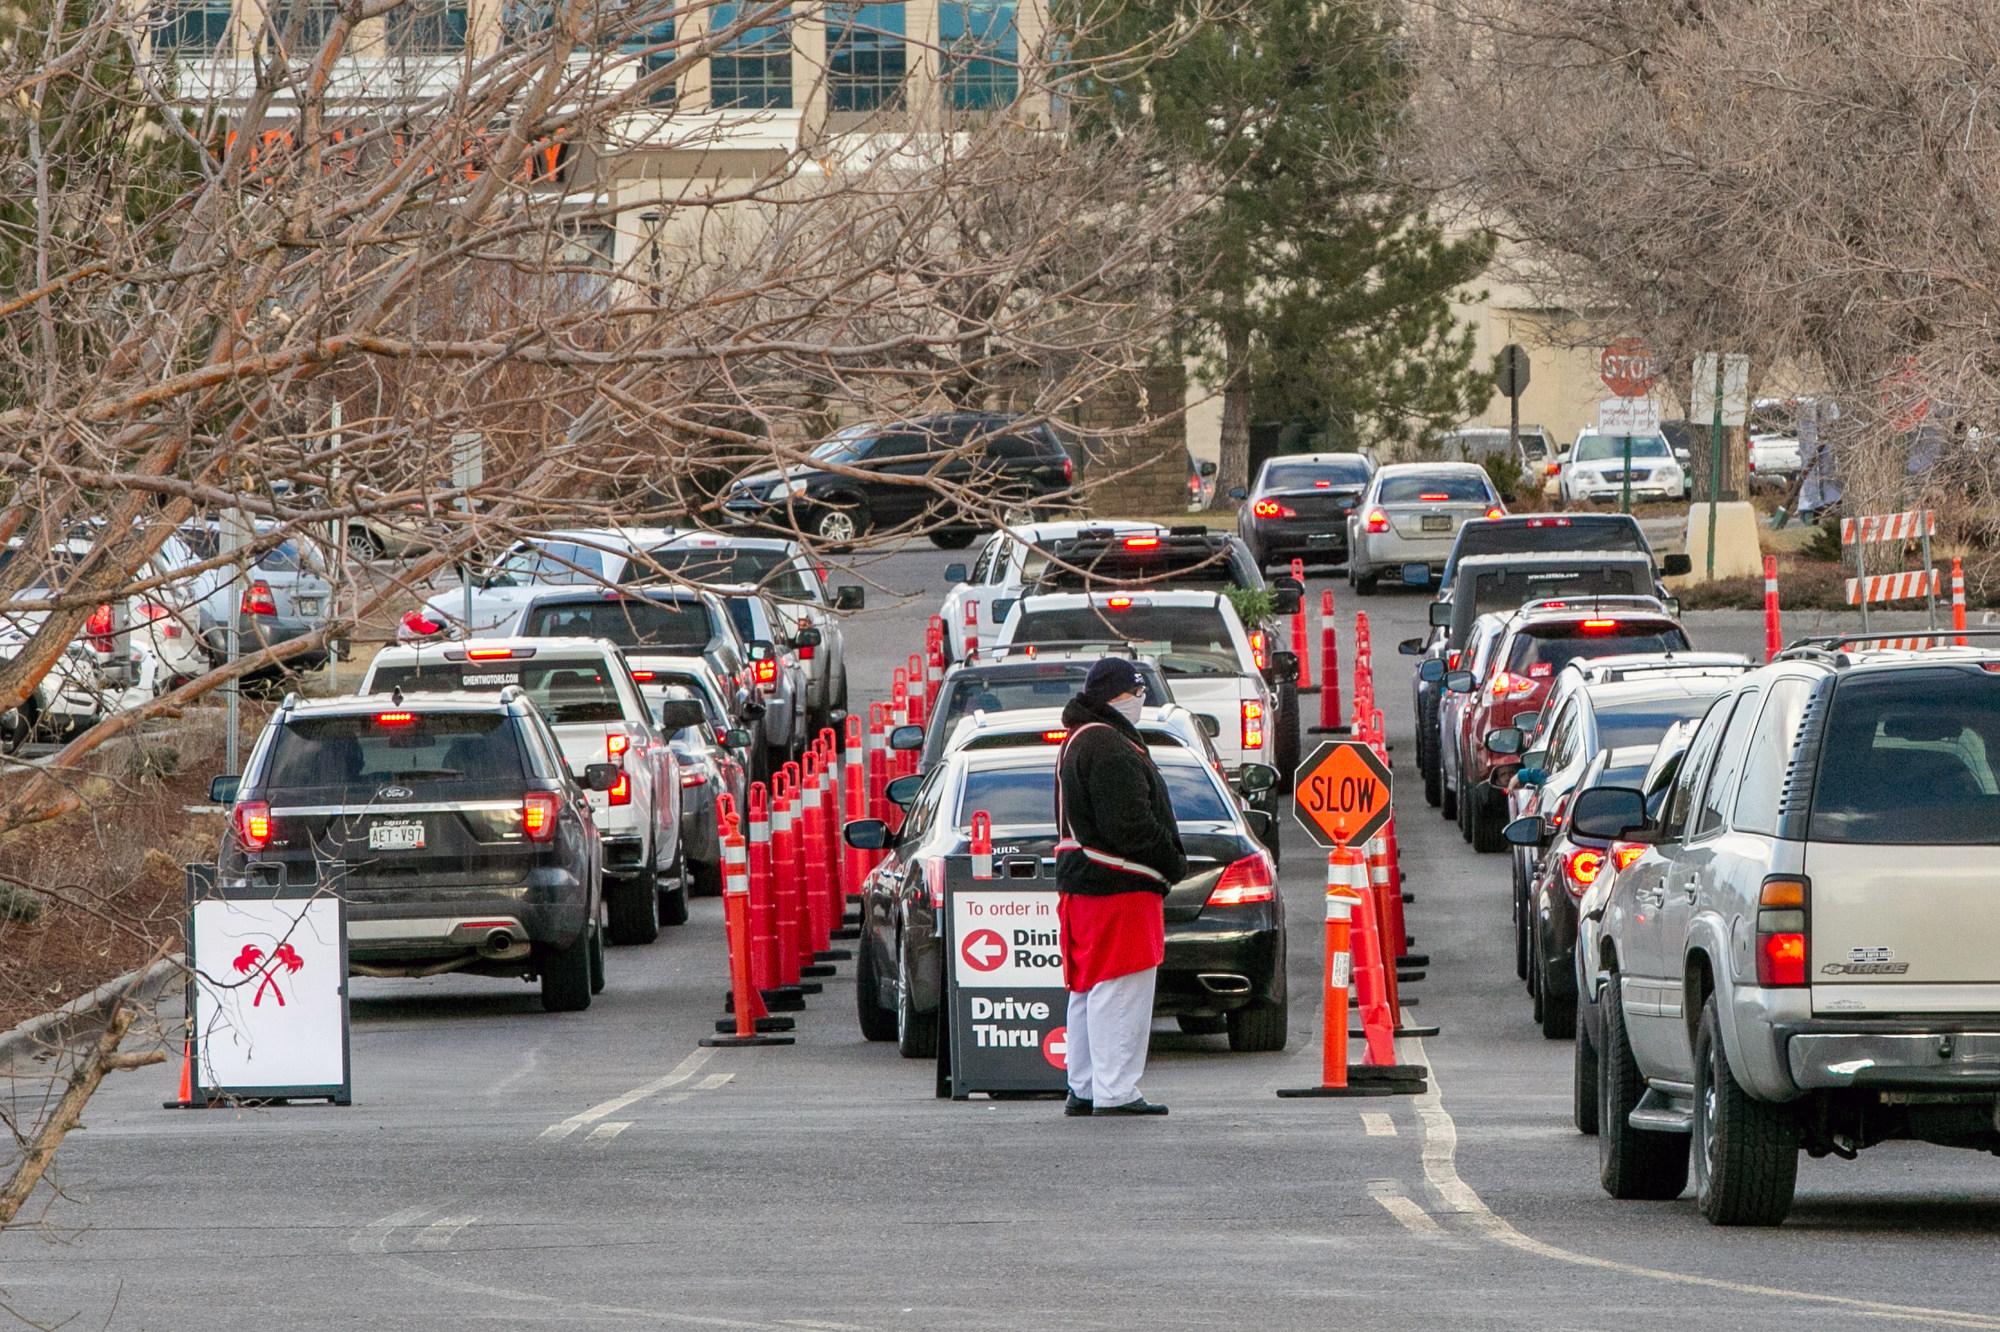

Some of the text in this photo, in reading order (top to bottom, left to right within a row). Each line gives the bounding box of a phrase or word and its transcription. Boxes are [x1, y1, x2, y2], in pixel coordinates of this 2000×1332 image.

[385, 789, 406, 798] Ford
[1310, 775, 1376, 813] SLOW
[966, 901, 1049, 916] To order in
[1013, 929, 1059, 946] Dini
[1014, 949, 1063, 968] Roo
[971, 997, 1049, 1020] Drive
[972, 1024, 1039, 1048] Thru
